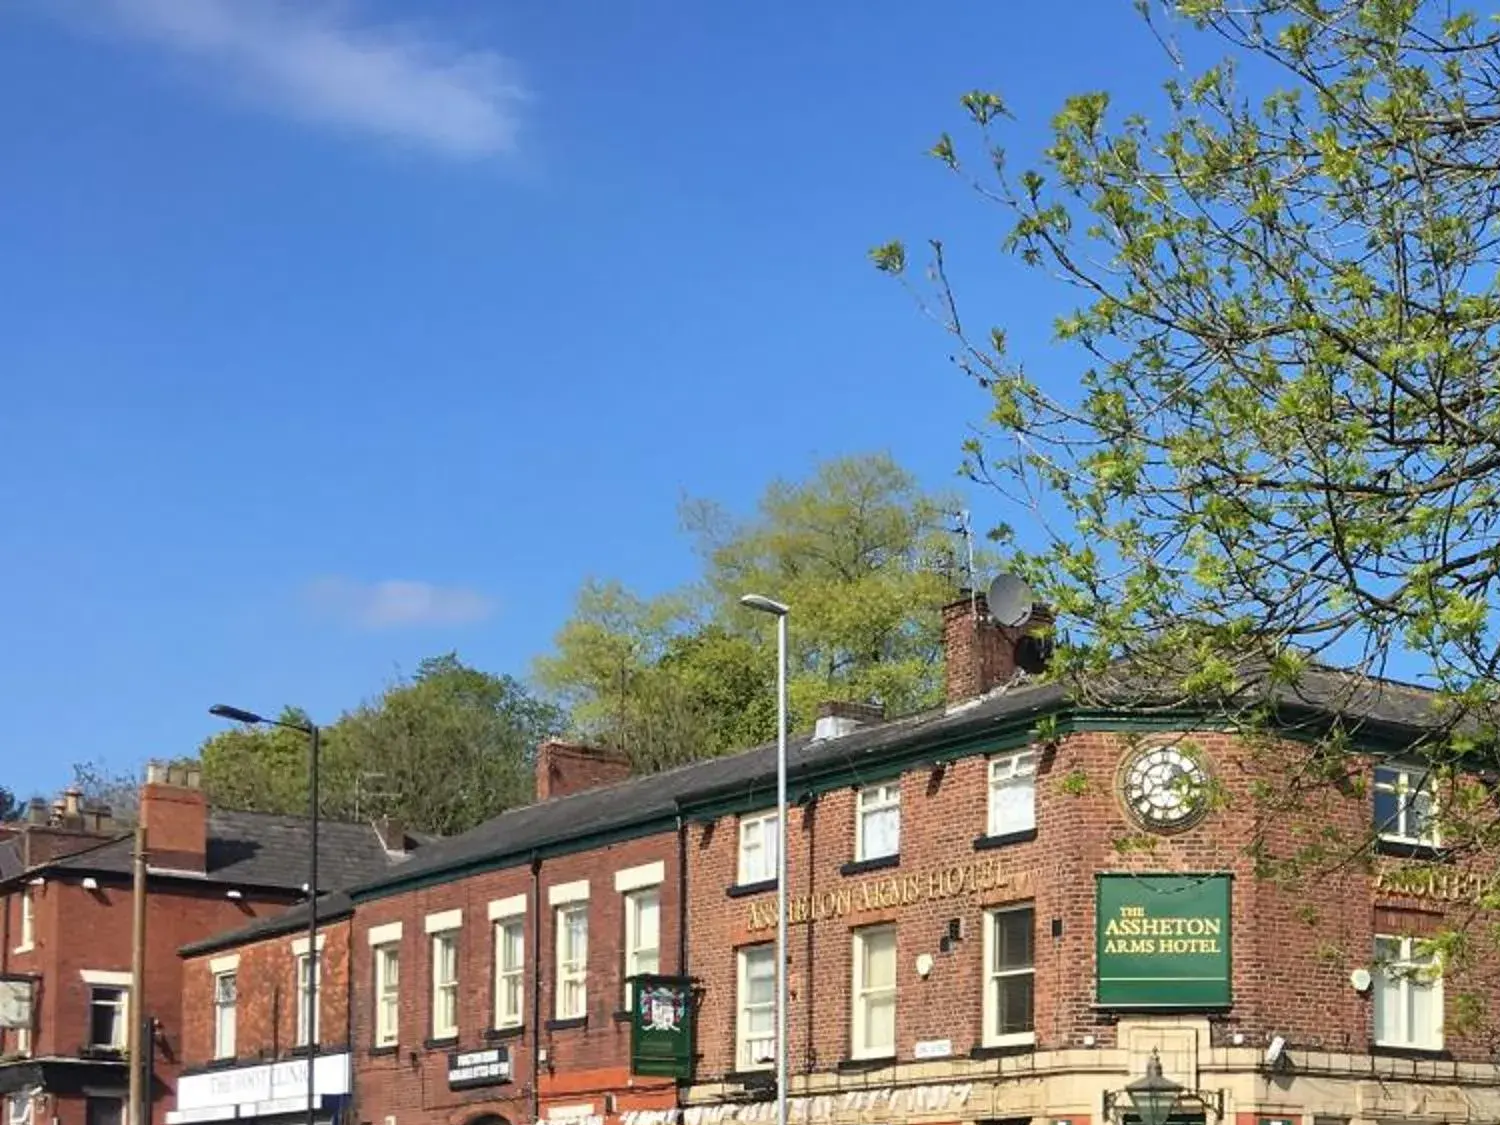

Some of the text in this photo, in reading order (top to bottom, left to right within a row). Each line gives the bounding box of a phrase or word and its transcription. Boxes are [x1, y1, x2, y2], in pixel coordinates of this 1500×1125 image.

[857, 875, 918, 912] ARMS
[930, 858, 1009, 901] HOTEL
[1120, 907, 1144, 917] THE
[1105, 919, 1221, 936] ASSHETON
[1104, 939, 1221, 953] ARMS HOTEL
